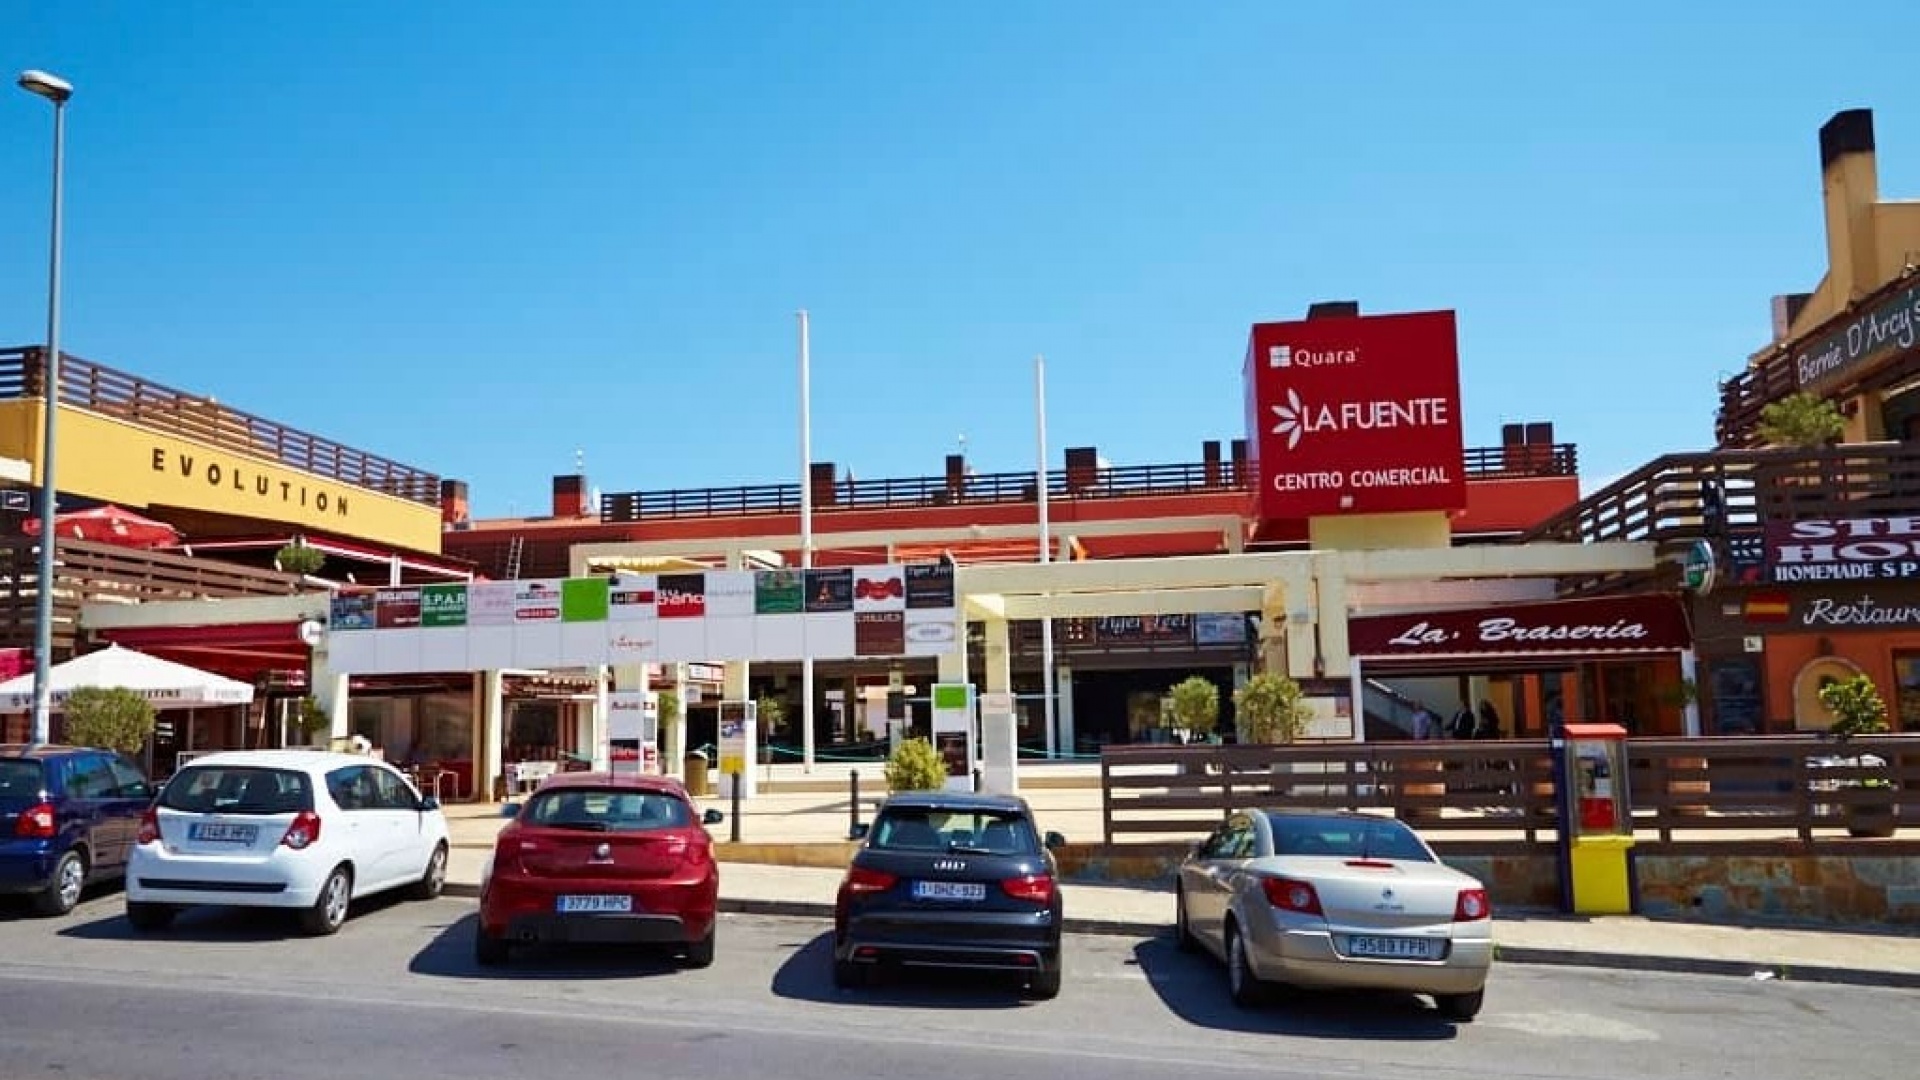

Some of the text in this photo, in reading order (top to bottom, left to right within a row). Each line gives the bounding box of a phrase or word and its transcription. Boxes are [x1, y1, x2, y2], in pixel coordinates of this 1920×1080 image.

[1294, 348, 1356, 367] Quara
[1797, 341, 1842, 384] Bernie
[1303, 398, 1448, 432] LA FUENTE
[152, 448, 349, 516] EVOLUTION
[1274, 466, 1450, 490] CENTRO COMERCIAL
[1776, 541, 1920, 562] HO
[1775, 563, 1875, 581] HOMEMADE
